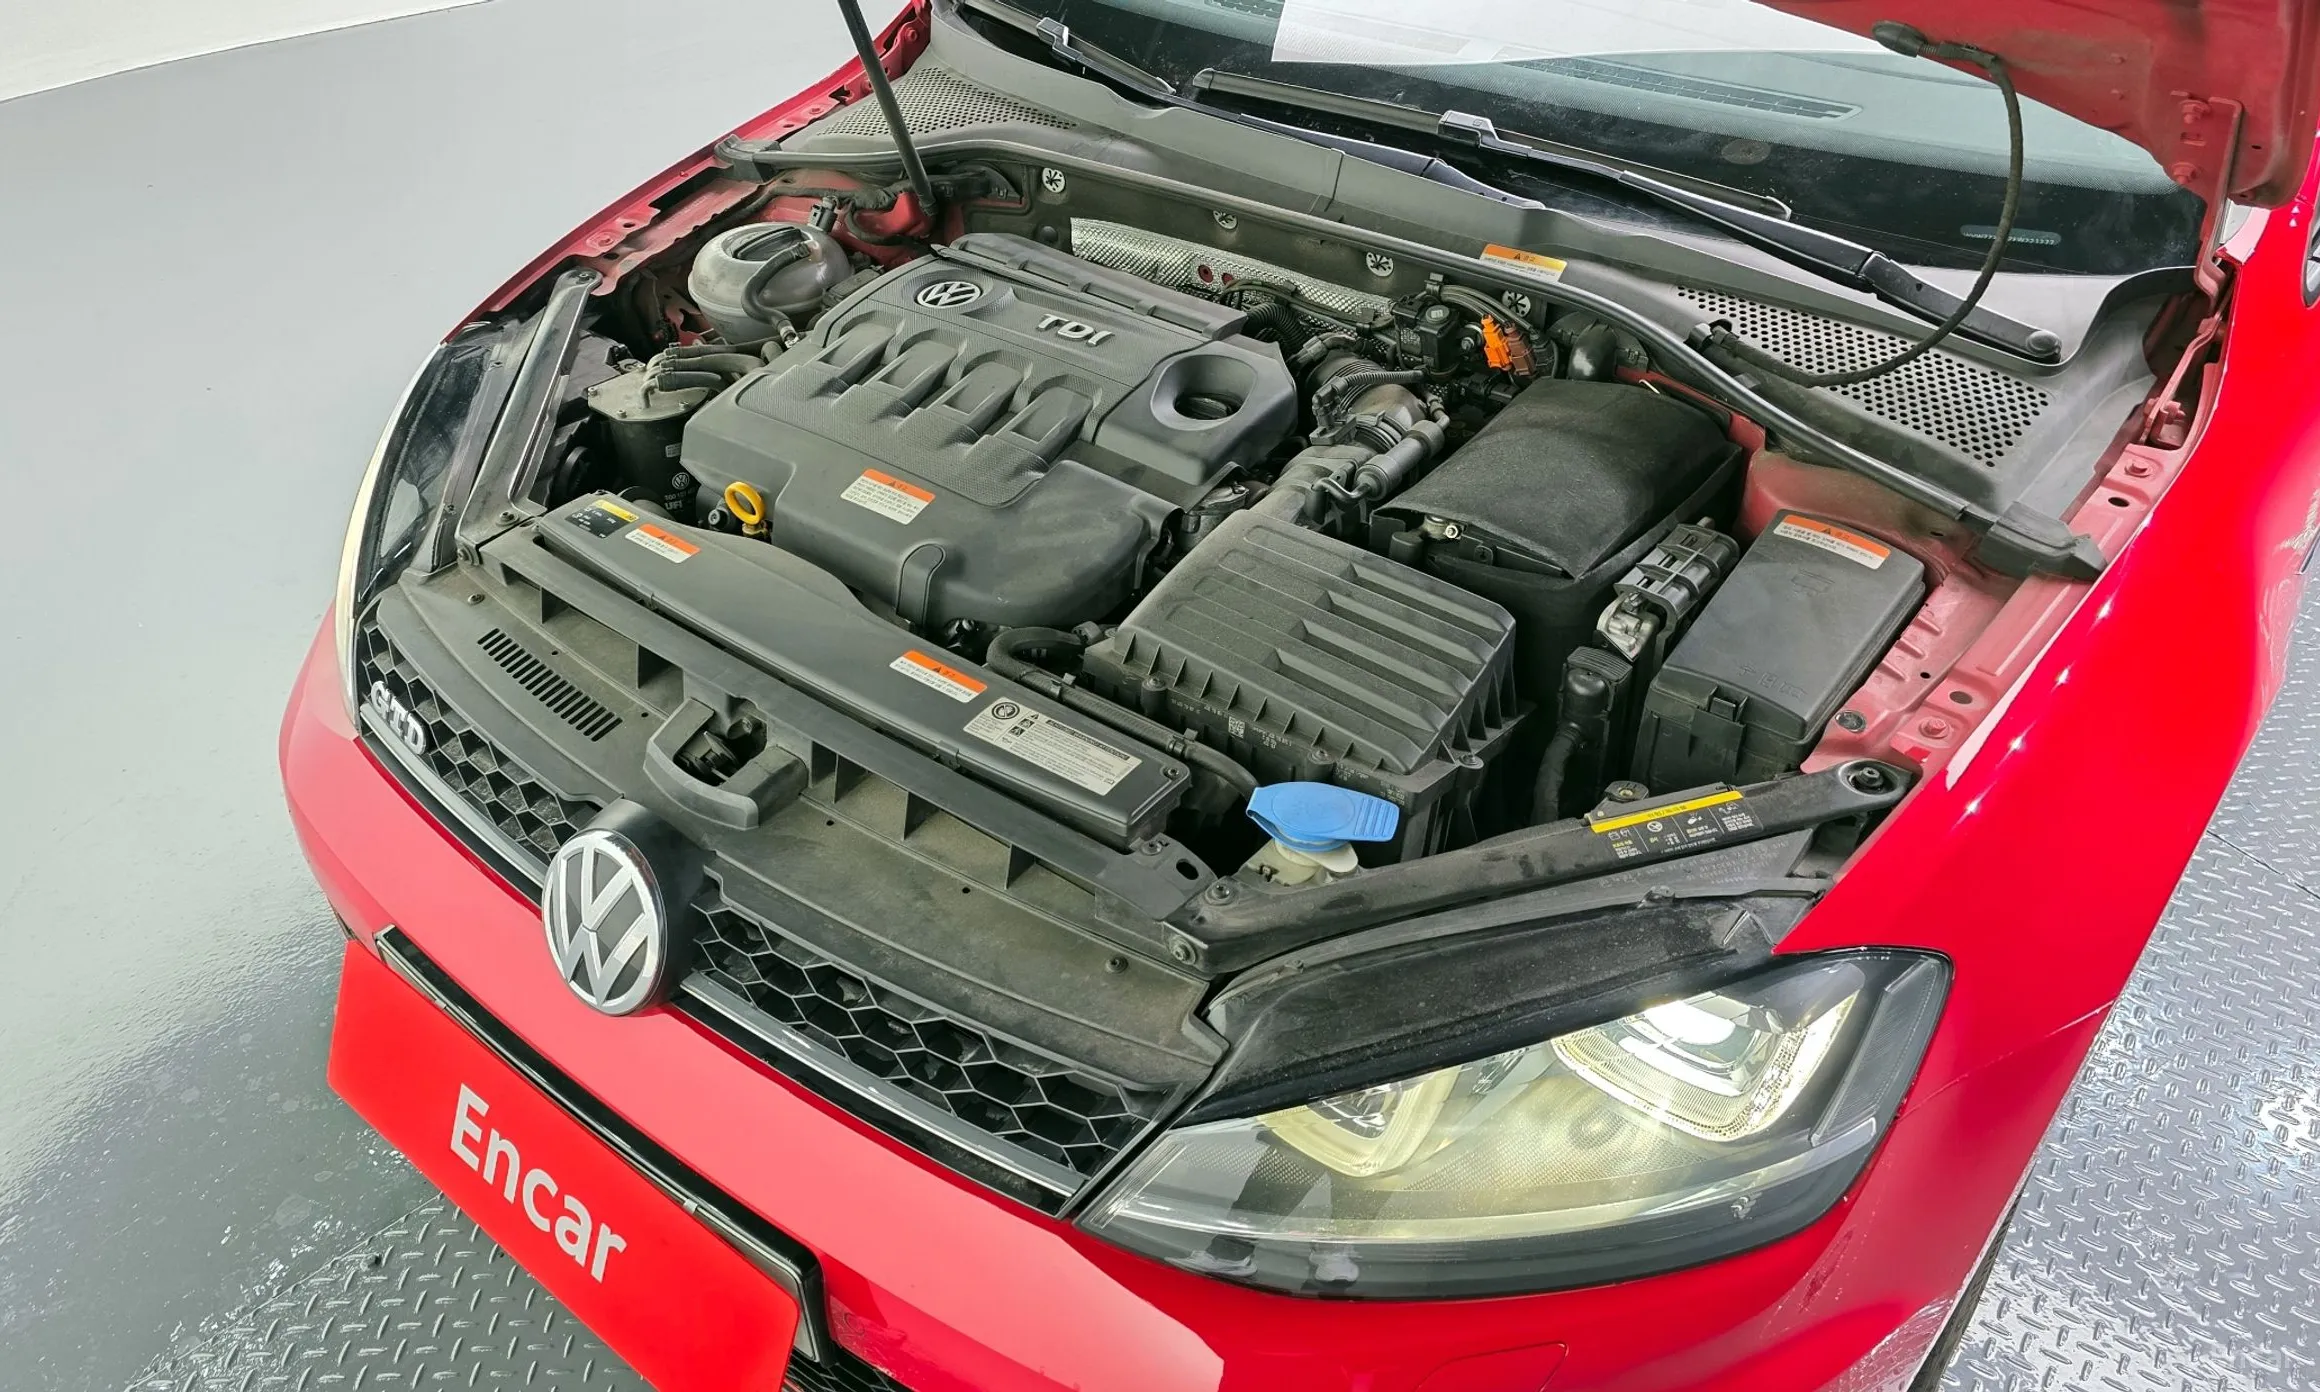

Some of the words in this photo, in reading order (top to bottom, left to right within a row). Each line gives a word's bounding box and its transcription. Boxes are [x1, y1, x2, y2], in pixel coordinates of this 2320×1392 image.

[1036, 313, 1114, 347] TDI
[371, 681, 426, 755] GTD
[451, 1082, 627, 1284] Encar
